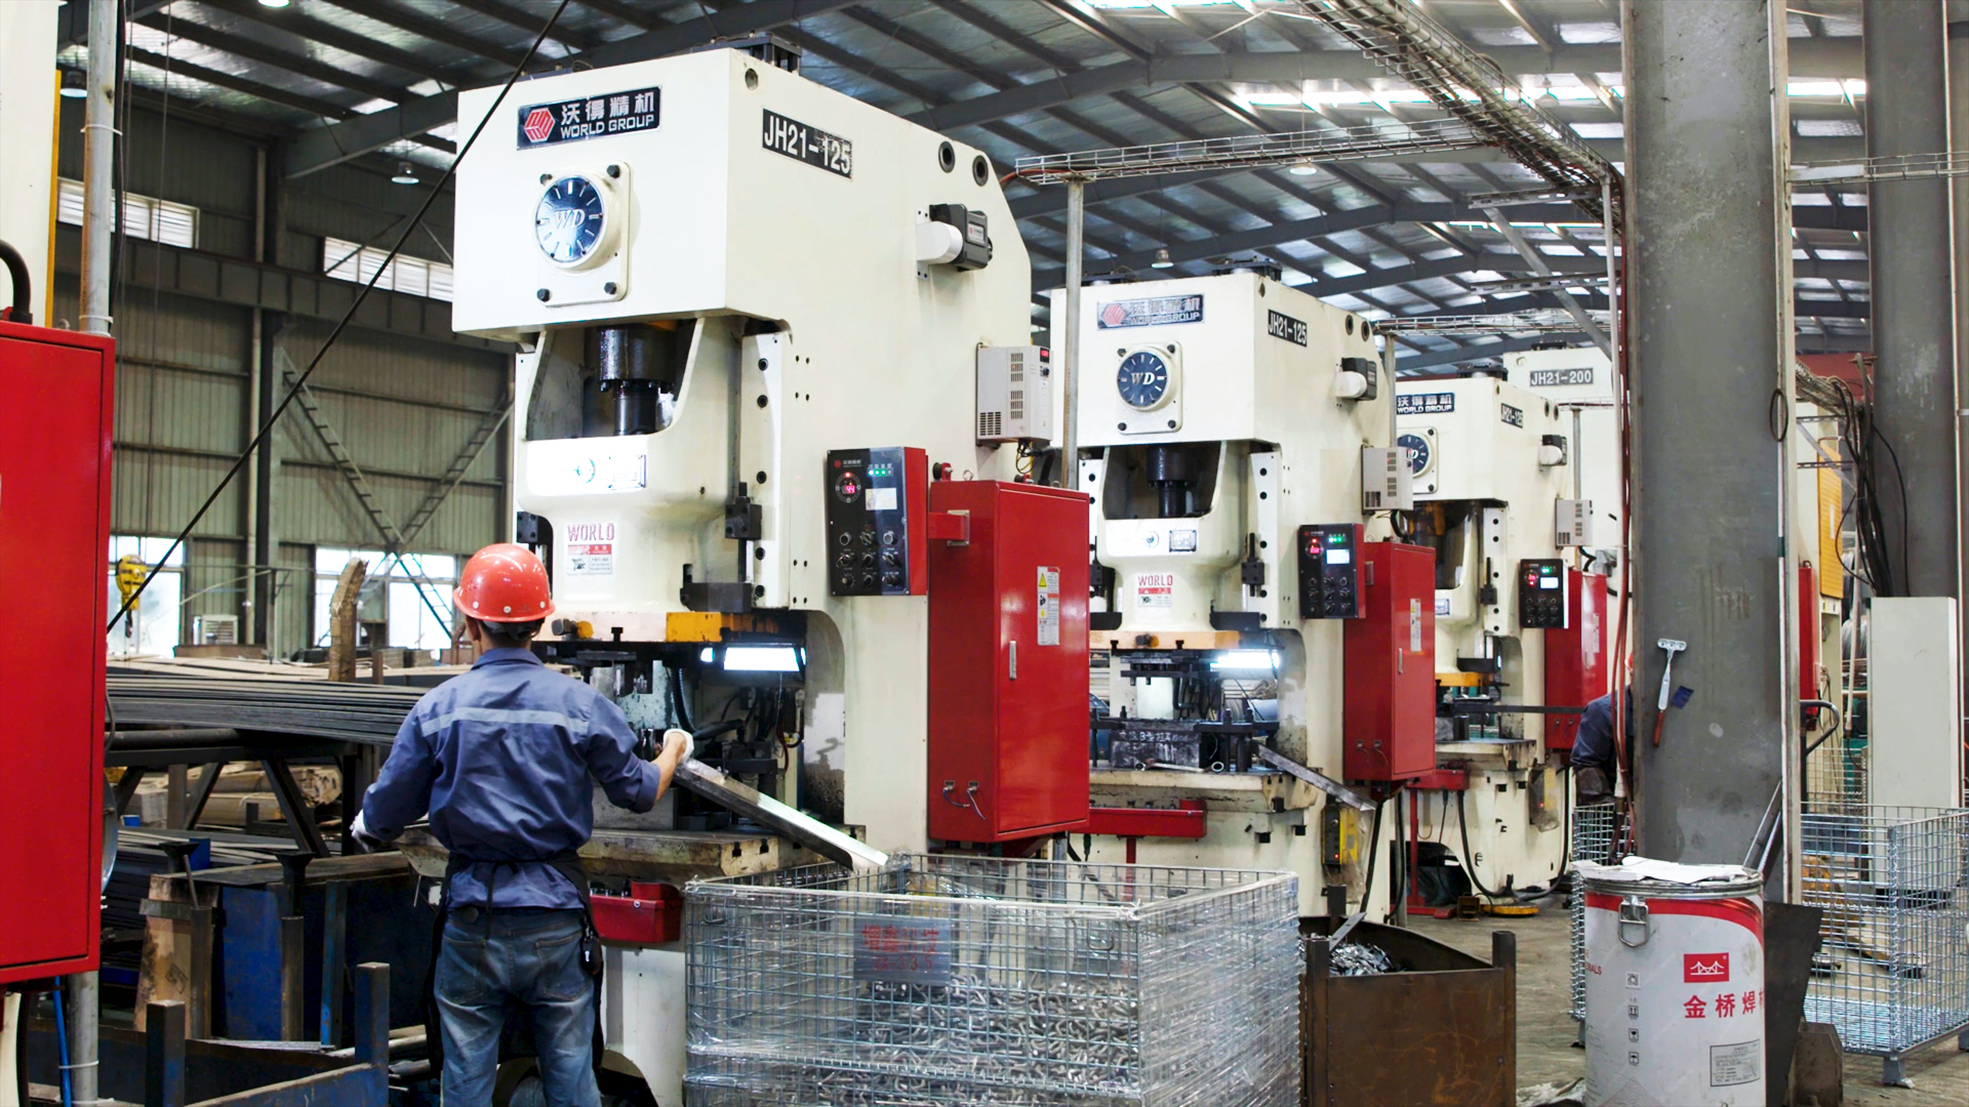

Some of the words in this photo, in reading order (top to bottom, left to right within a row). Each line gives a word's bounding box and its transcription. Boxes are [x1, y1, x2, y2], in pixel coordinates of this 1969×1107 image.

[561, 92, 654, 126] 沃得精机
[561, 121, 605, 139] WORLD
[608, 114, 654, 132] GROUP
[764, 115, 851, 174] JH21-125
[1269, 312, 1307, 345] JH21-125
[1131, 372, 1155, 385] WD
[1531, 370, 1592, 385] JH21-200
[1397, 406, 1424, 414] WORLD
[1425, 404, 1452, 412] GROUP
[567, 523, 615, 542] WORLD
[1138, 575, 1173, 586] WORLD
